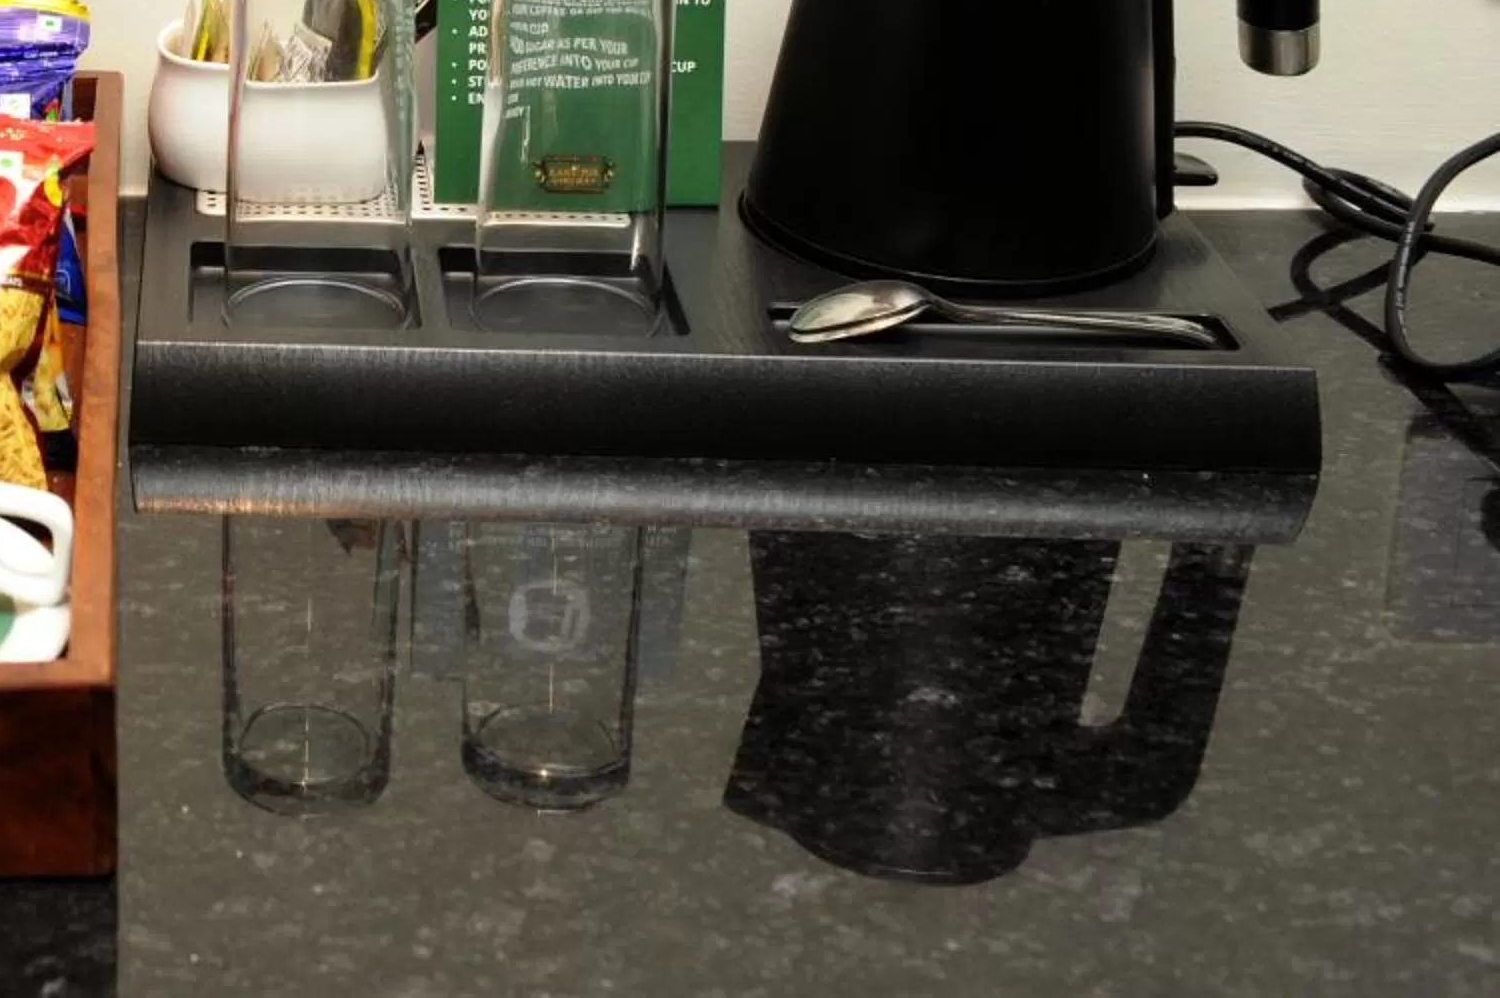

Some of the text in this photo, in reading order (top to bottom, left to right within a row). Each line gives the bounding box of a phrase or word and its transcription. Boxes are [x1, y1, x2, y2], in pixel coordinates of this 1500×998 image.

[573, 38, 596, 51] PER
[599, 39, 628, 55] YOUR
[543, 74, 589, 89] WATER
